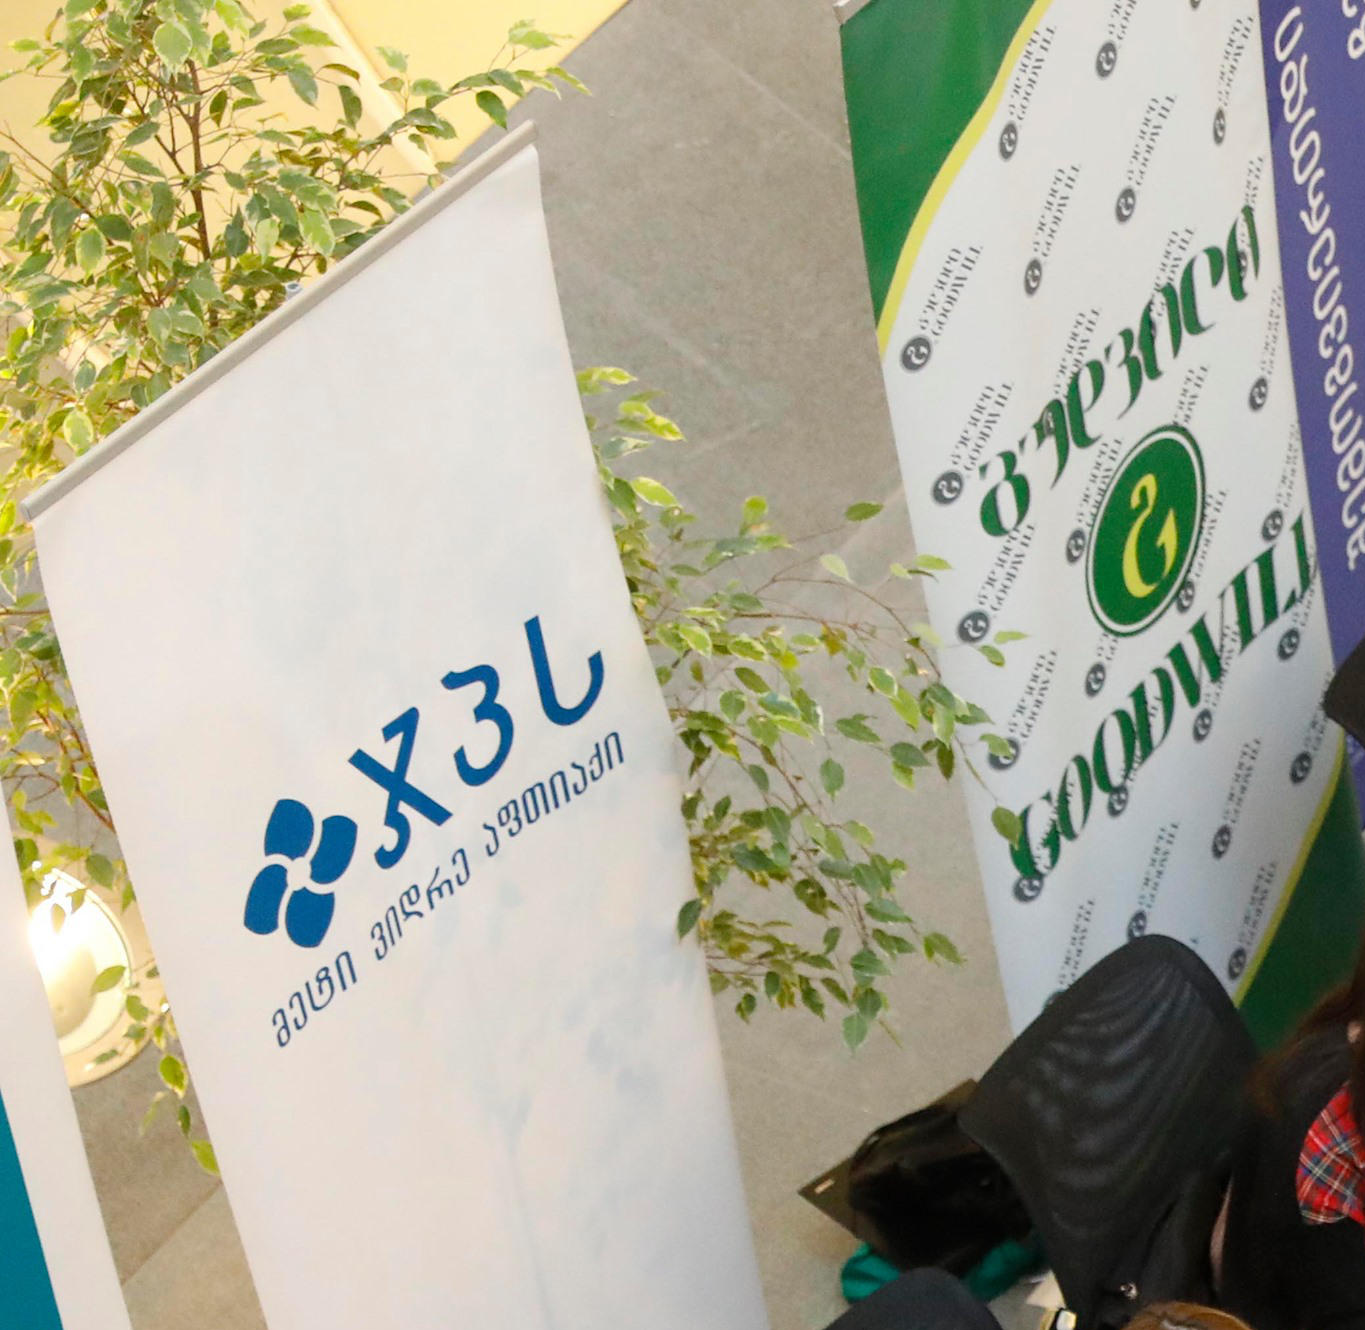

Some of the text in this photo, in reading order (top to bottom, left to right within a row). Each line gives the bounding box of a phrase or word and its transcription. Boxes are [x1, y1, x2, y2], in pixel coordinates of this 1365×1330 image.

[932, 247, 980, 336] GOODWILL
[1008, 512, 1320, 882] GOODWILL
[271, 731, 625, 1048] მეტი ვიდრე აფთიაქი
